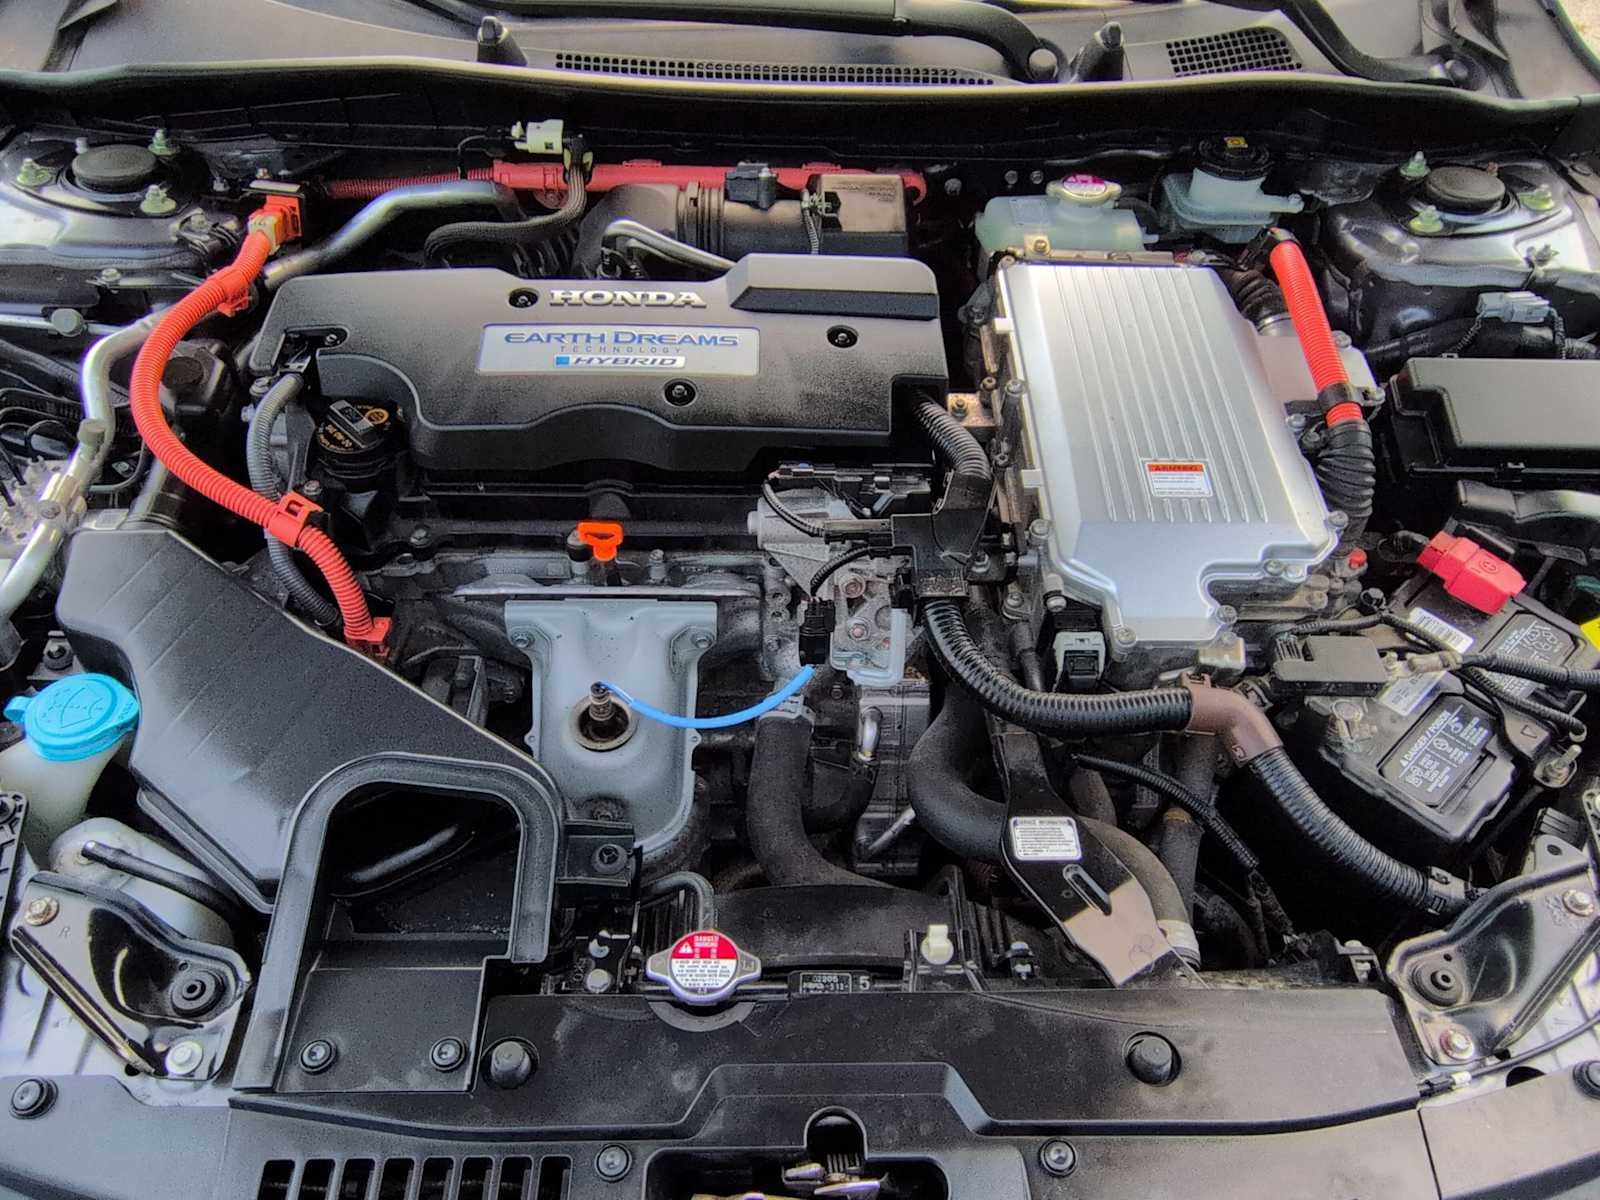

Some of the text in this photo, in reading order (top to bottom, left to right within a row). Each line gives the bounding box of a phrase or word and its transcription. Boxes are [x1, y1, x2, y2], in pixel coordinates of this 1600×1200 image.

[549, 290, 707, 308] HONDA
[504, 332, 738, 346] EARTH DREAMS
[573, 355, 677, 366] HYBRID
[859, 975, 870, 990] 5
